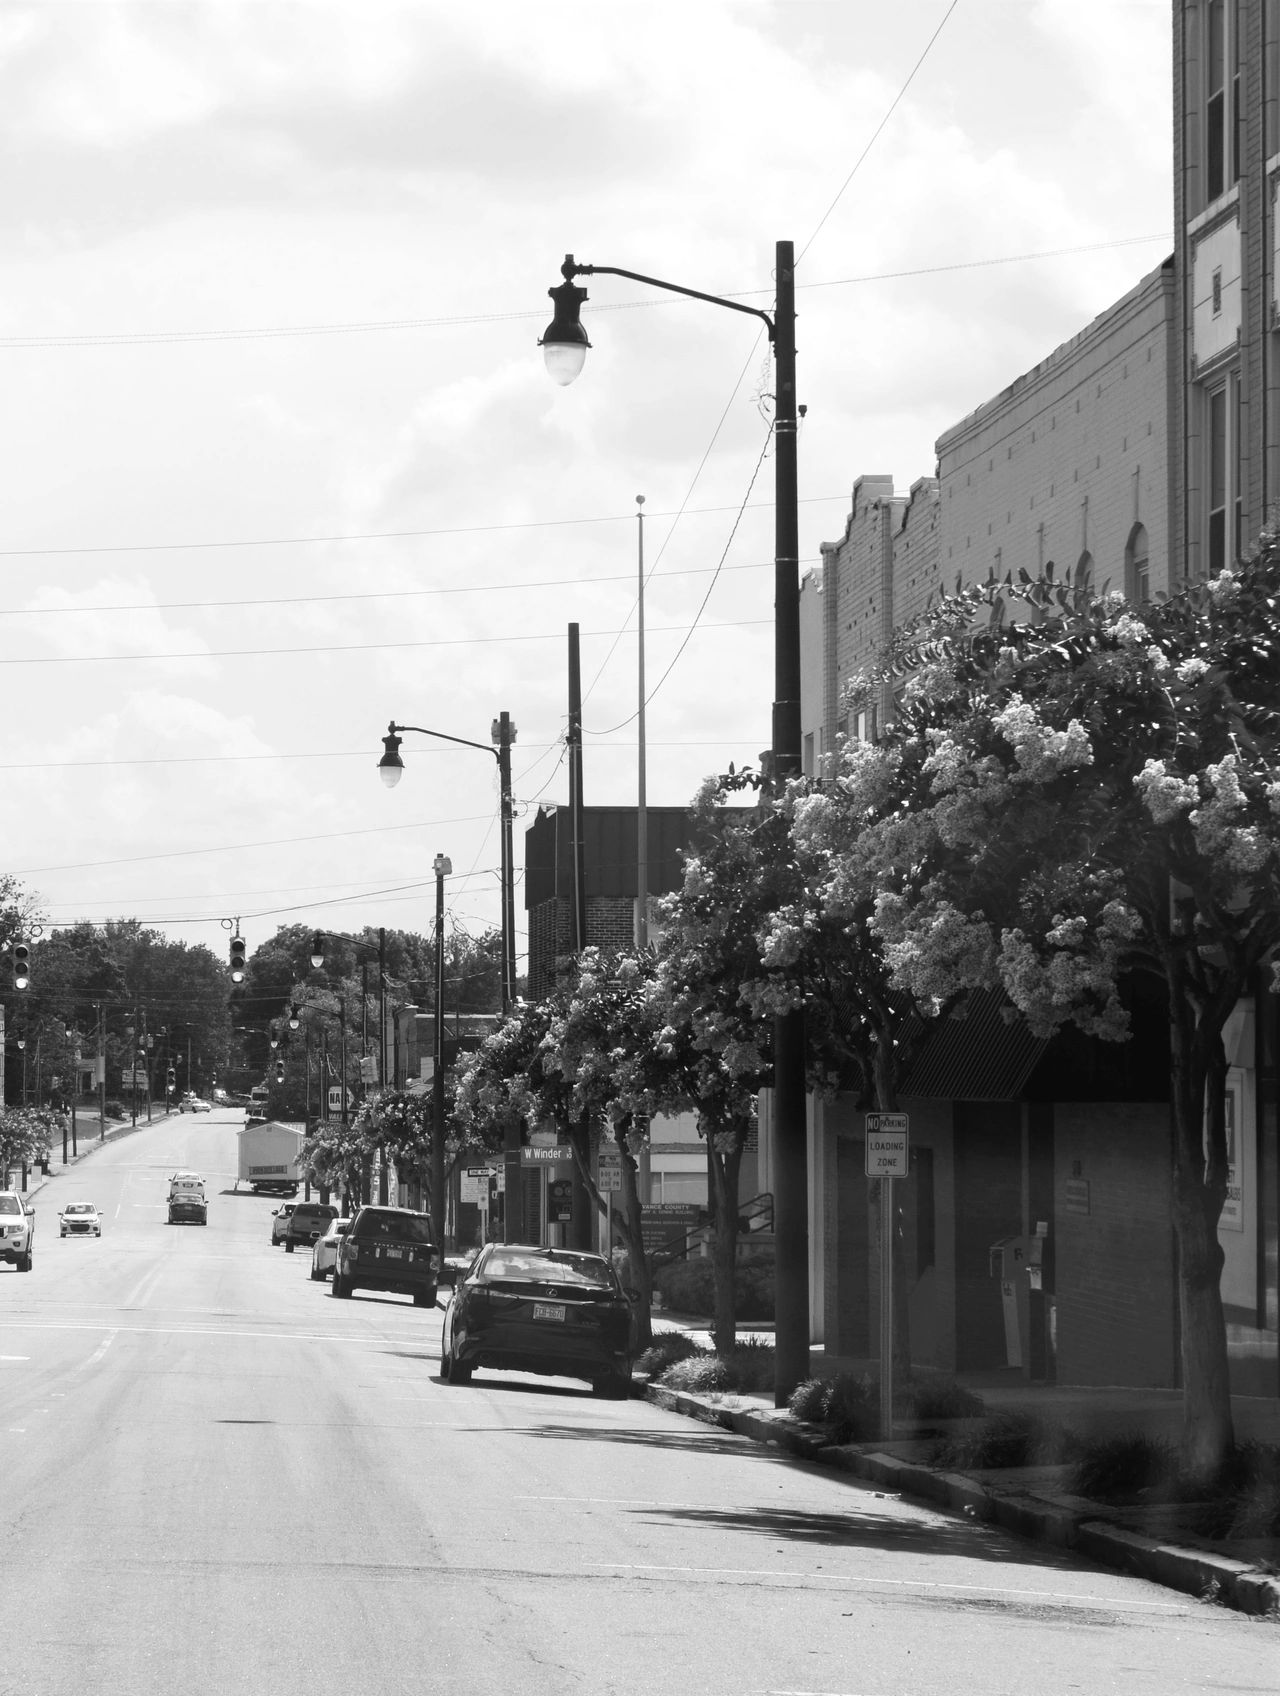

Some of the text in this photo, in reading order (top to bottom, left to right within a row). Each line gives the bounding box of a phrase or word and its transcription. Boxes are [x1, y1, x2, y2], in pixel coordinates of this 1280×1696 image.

[867, 1117, 906, 1130] NO PARKING
[870, 1142, 904, 1151] LOADING
[524, 1148, 562, 1159] W Winder
[877, 1158, 898, 1167] ZONE
